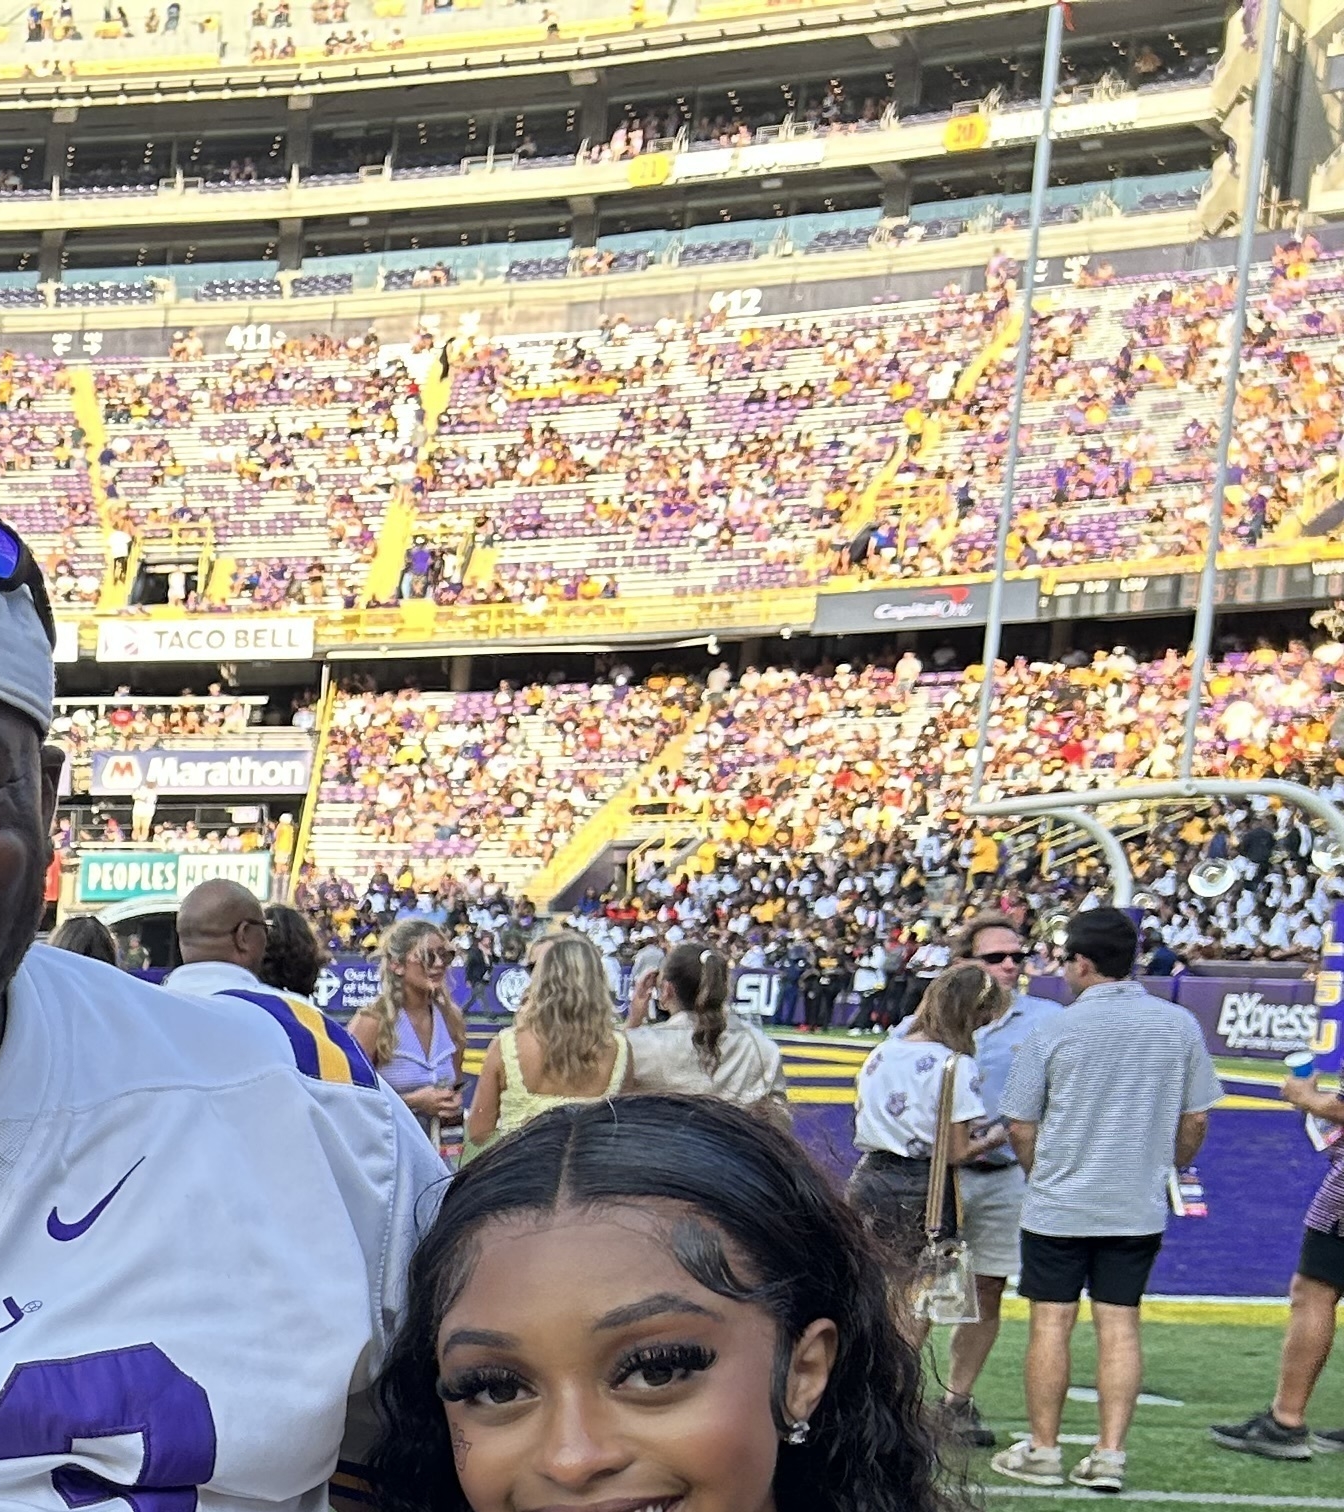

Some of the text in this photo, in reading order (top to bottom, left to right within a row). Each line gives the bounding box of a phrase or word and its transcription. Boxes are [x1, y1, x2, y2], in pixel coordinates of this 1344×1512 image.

[225, 324, 271, 351] 411
[154, 629, 299, 650] TACO BELL
[146, 755, 305, 787] Marathon
[87, 861, 177, 892] PEOPLES
